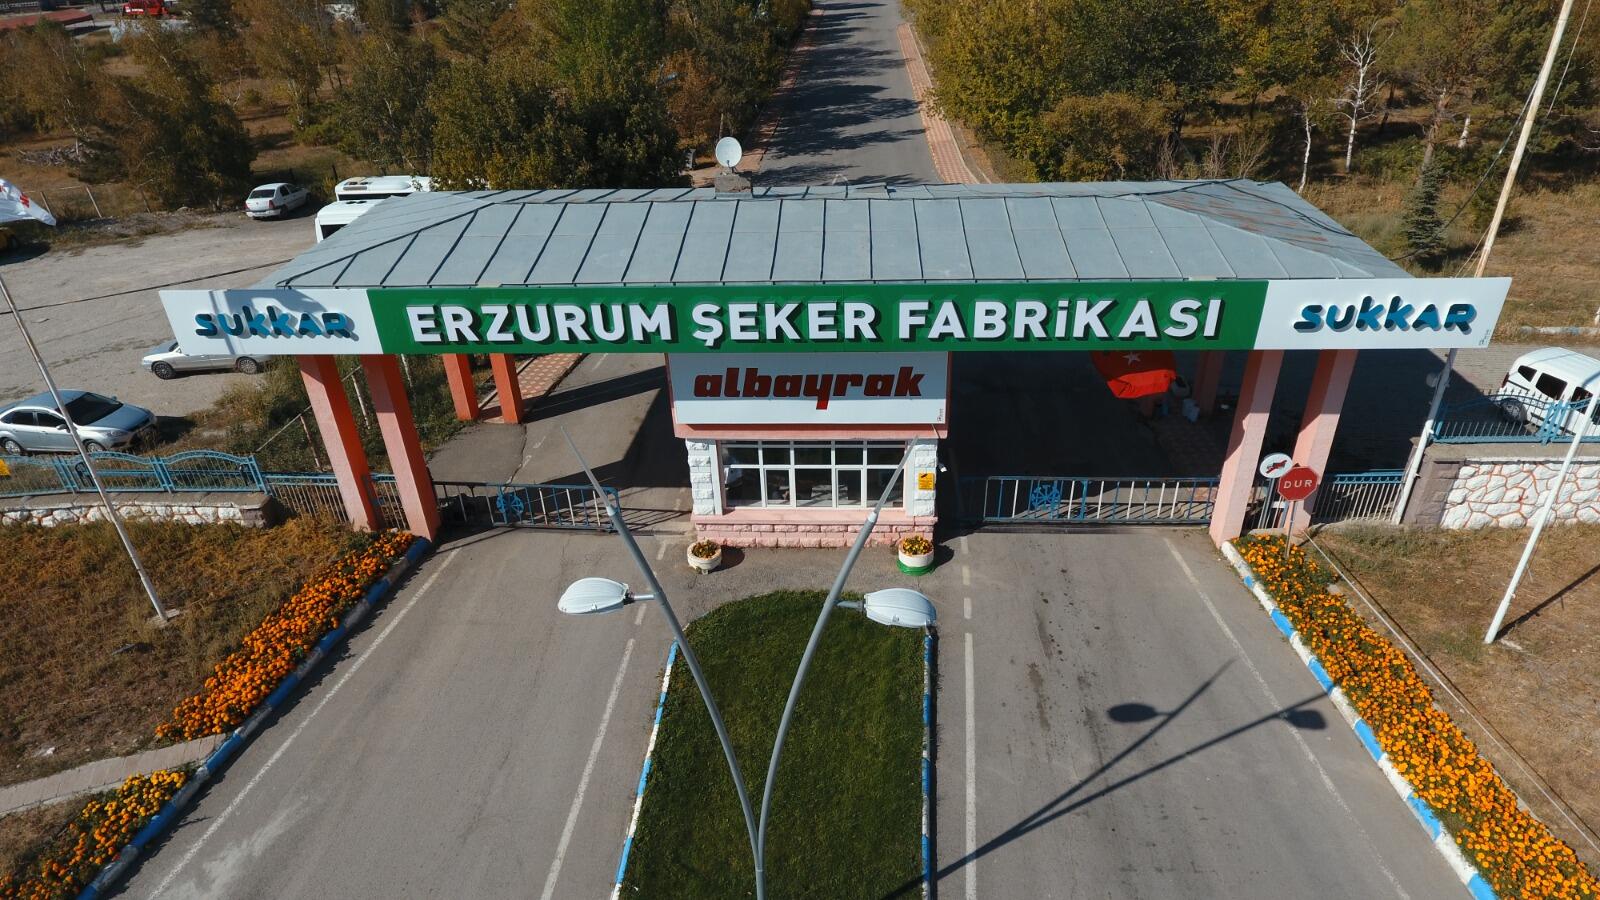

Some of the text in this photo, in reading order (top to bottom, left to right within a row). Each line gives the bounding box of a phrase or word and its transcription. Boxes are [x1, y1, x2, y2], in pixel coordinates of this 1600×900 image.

[407, 304, 672, 343] ERZURUM
[692, 302, 876, 346] ŞEKER
[694, 366, 924, 411] albayrak
[1283, 479, 1313, 489] DUR
